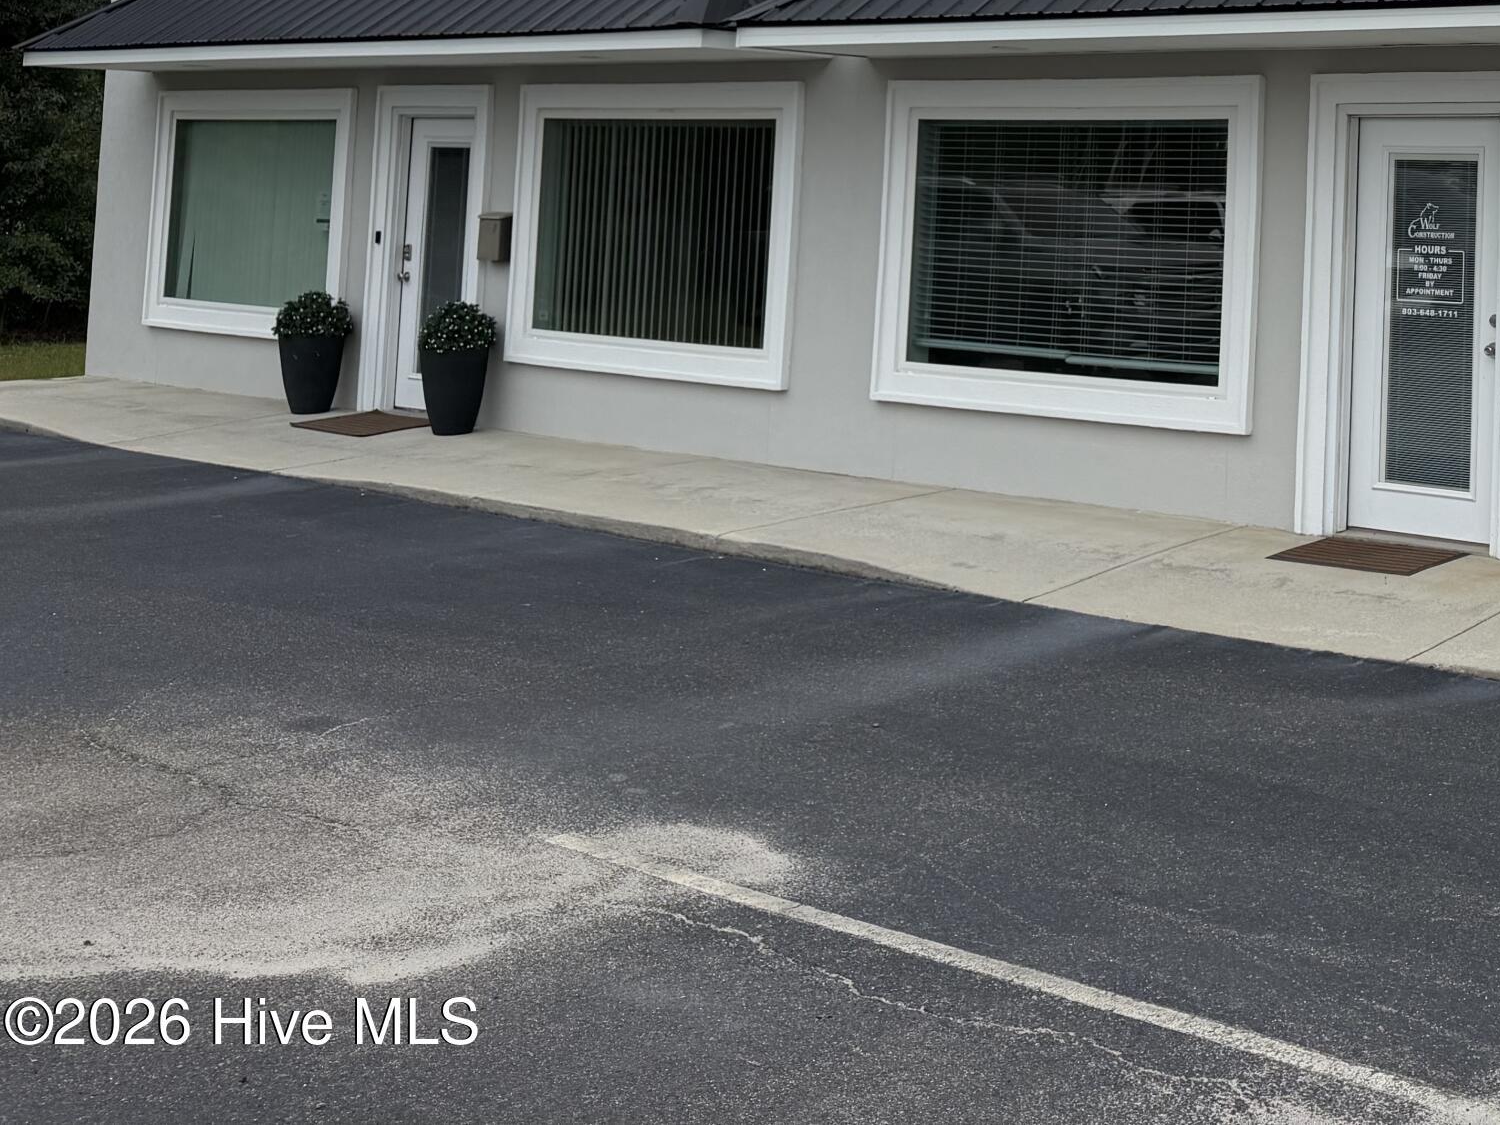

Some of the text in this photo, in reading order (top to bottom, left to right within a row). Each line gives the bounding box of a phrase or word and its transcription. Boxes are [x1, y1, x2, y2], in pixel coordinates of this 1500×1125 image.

[1414, 245, 1447, 255] HOURS
[1409, 256, 1425, 264] MON
[1429, 257, 1453, 265] THURS
[1418, 272, 1442, 280] FRIDAY
[1406, 287, 1455, 296] APPOINTMENT
[1401, 307, 1459, 318] 803-648-1711
